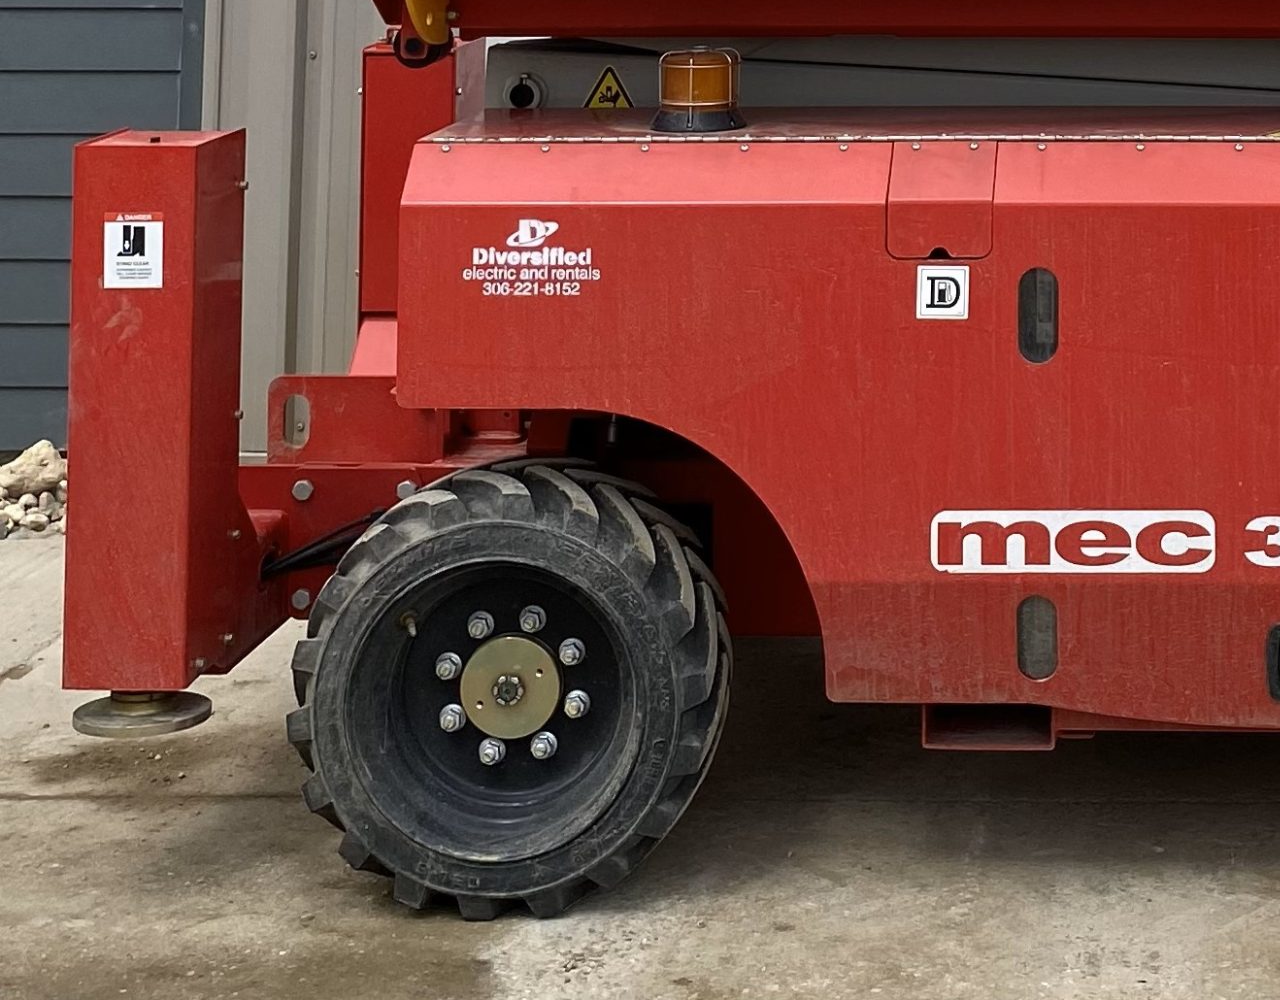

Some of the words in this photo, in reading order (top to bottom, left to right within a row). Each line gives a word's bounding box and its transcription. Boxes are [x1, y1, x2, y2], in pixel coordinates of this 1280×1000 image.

[472, 246, 592, 265] Diversified
[462, 265, 517, 280] electric
[519, 265, 548, 280] and
[551, 265, 600, 280] rentals
[482, 282, 581, 296] 306-221-8152
[926, 276, 961, 308] D
[936, 519, 1213, 568] mec
